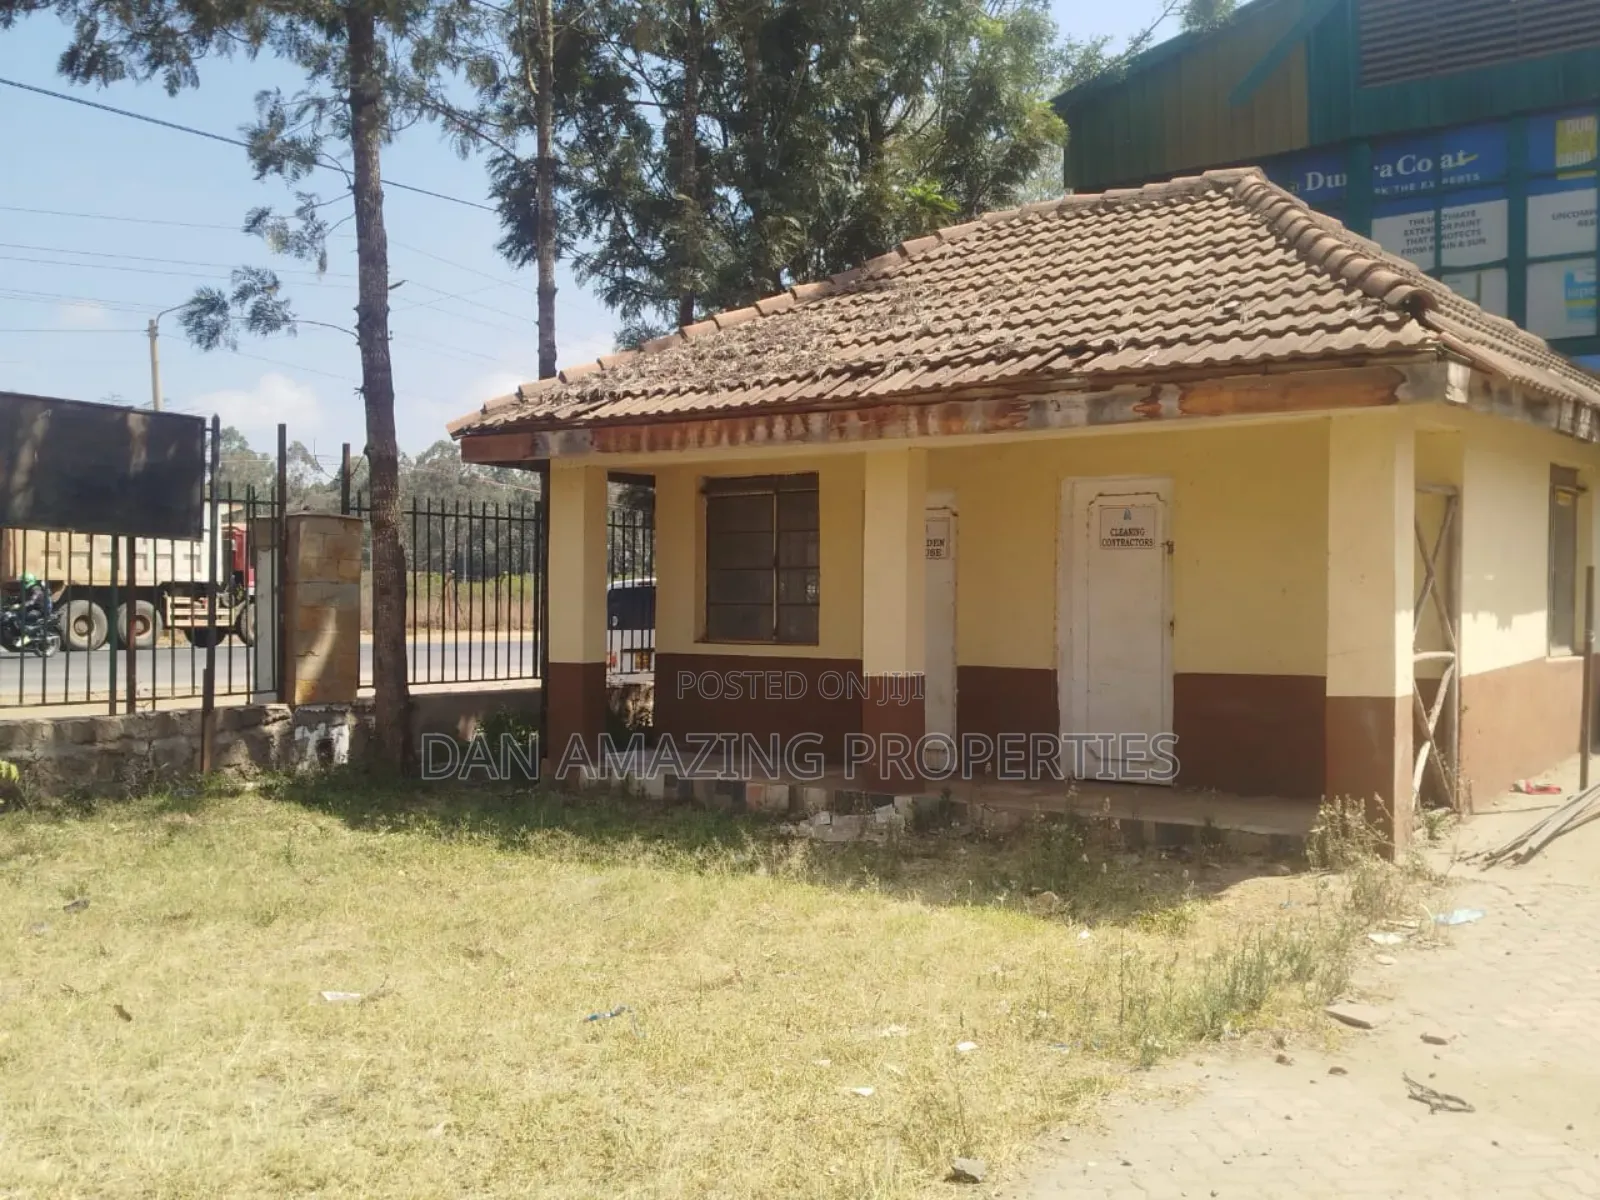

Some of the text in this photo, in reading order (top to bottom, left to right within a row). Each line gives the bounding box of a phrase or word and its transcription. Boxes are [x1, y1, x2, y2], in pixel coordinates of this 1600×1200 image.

[1393, 183, 1416, 193] THE
[1110, 527, 1145, 537] CLEANING
[1101, 538, 1154, 548] CONTRACTORS
